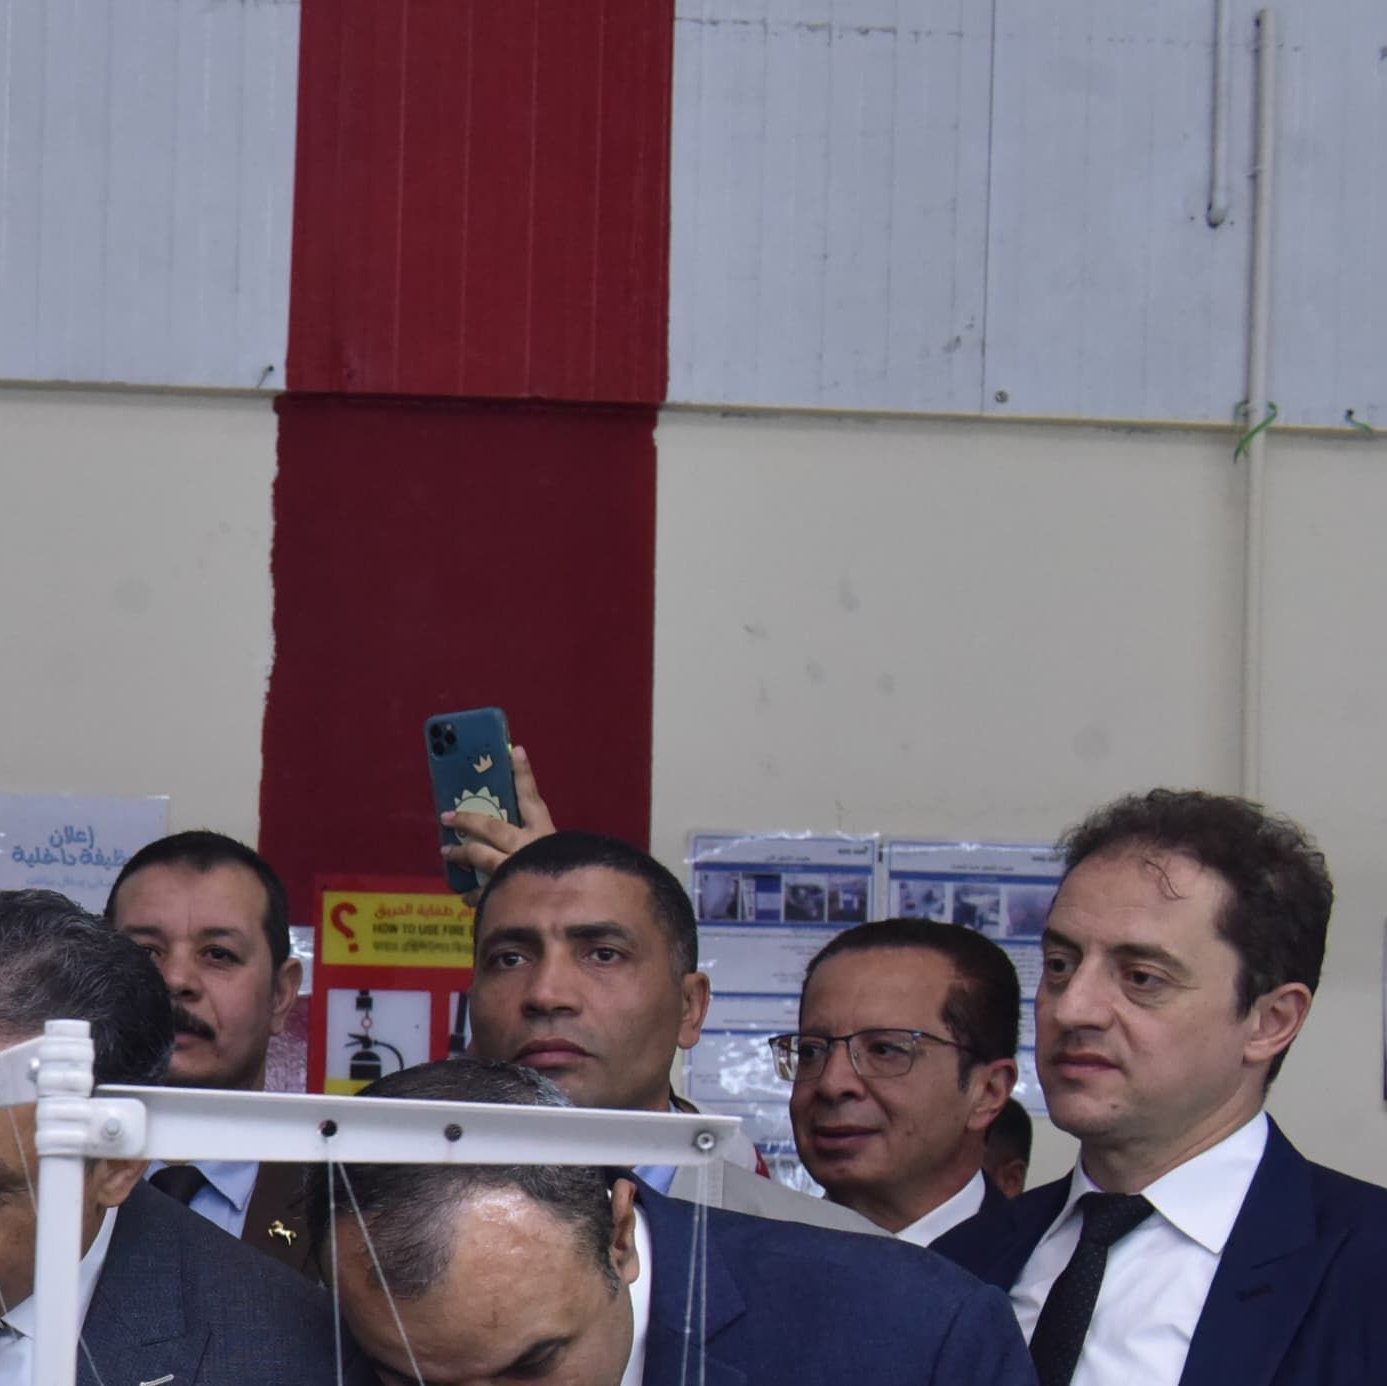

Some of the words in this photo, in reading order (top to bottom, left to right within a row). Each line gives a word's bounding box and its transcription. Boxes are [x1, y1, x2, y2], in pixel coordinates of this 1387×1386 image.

[49, 825, 96, 849] إعلان
[11, 843, 77, 868] داخلية
[78, 847, 129, 871] ظيفة
[372, 923, 398, 935] HOW
[402, 923, 417, 935] TO
[418, 923, 439, 936] USE
[443, 924, 465, 936] FIRE
